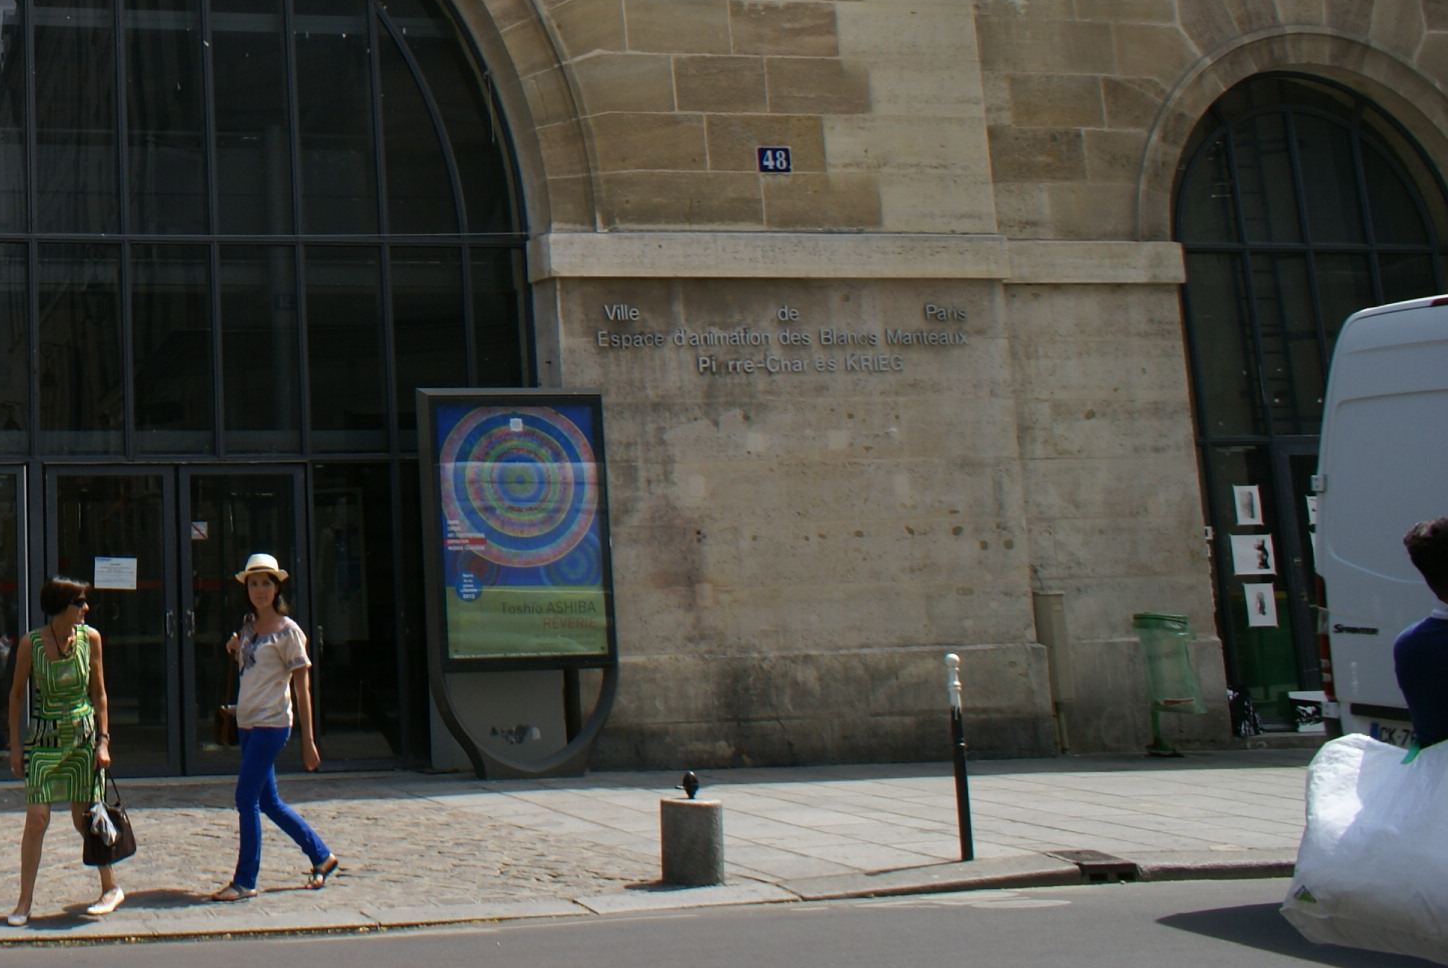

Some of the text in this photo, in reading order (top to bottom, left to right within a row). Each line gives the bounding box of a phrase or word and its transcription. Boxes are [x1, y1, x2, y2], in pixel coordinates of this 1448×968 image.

[762, 149, 788, 170] 48
[604, 304, 968, 321] Ville de Paris
[597, 328, 969, 349] Espace d'animation des Blancs Manteaux
[846, 354, 904, 372] KRIEG
[500, 600, 597, 614] Toshio ASHIBA
